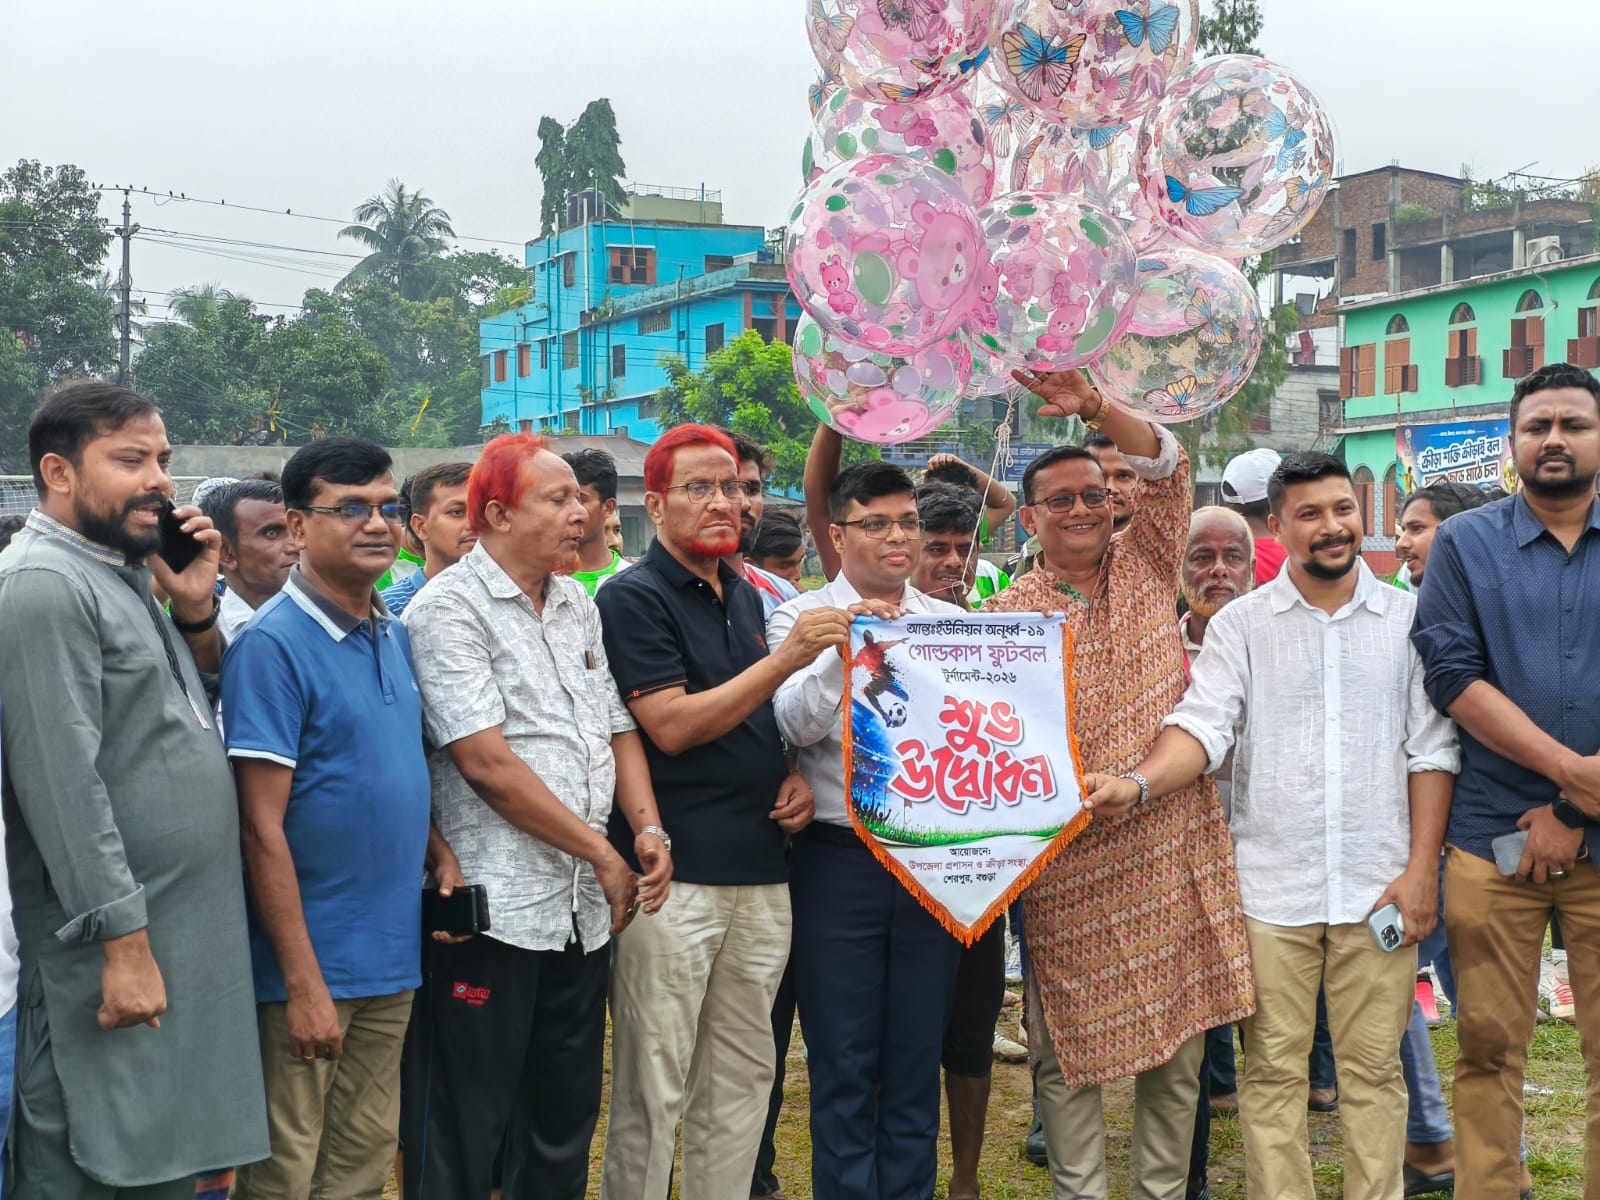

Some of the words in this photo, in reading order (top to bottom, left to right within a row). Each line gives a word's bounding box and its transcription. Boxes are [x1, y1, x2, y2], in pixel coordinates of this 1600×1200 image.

[1421, 448, 1442, 469] ক্রীড়া
[1443, 445, 1461, 464] শক্তি
[1462, 439, 1485, 460] ক্রীড়াই
[1487, 439, 1500, 454] বল
[1466, 461, 1483, 482] মাঠে
[1484, 463, 1498, 478] চল
[906, 620, 982, 636] আন্তঃইউনিয়ন
[908, 644, 983, 662] গোল্ডকাপ
[987, 641, 1047, 668] ফুটবল
[939, 695, 1020, 758] শুভ
[891, 739, 1053, 811] উদ্বোধন
[908, 859, 943, 871] উপজেলা
[945, 860, 973, 871] প্রশাসন
[976, 860, 983, 868] ও
[985, 858, 1005, 869] ক্রীড়া
[976, 872, 997, 882] বগুড়া
